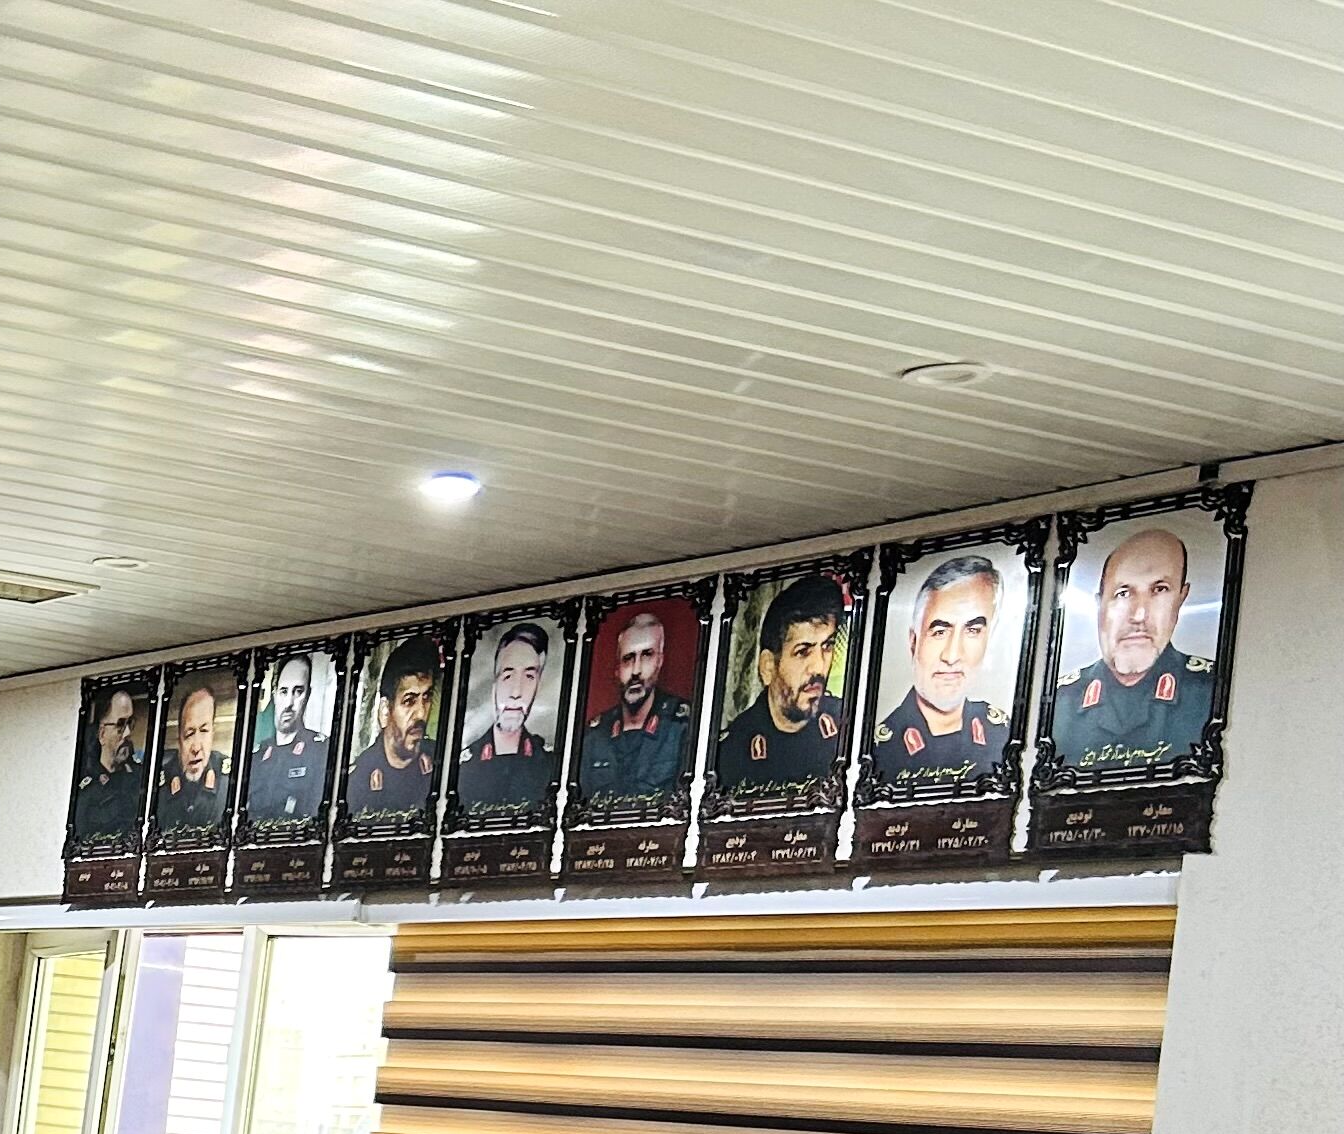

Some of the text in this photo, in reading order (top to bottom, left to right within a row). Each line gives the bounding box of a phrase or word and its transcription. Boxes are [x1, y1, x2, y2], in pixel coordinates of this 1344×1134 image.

[1065, 804, 1173, 825] معارفه تودیع
[885, 818, 978, 837] معارفه تودیع
[1049, 822, 1185, 843] ۱۳۷۰/۱۲/۱۵ ۱۳۷۵/۰۲/۳۰
[638, 840, 660, 854] معارفه
[725, 829, 808, 849] معارفه تودیع
[871, 835, 989, 853] ۱۳۷۵/۰۲/۳۰ ۱۳۷۹/۰۶/۳۱
